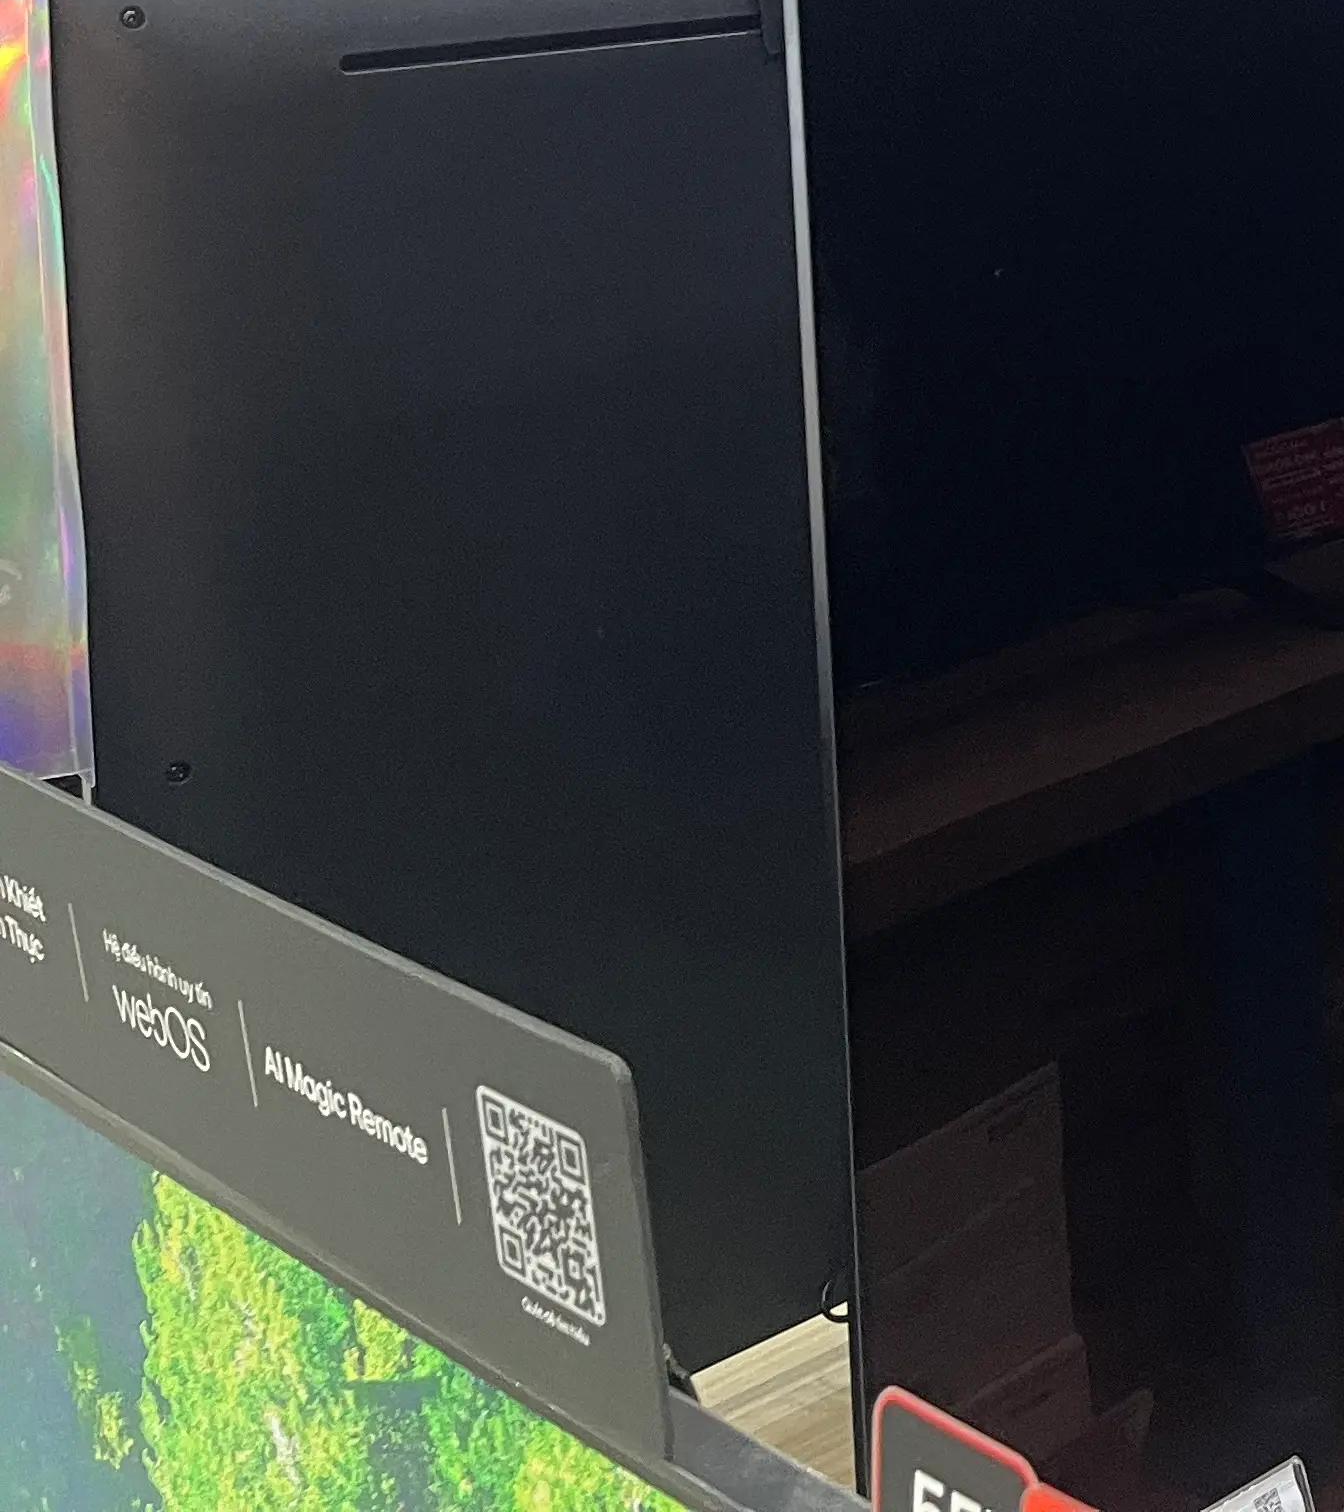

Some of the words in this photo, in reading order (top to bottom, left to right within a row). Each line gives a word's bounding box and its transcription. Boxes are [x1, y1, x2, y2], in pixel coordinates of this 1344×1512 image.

[112, 985, 210, 1072] webOS
[265, 1046, 284, 1084] AI
[284, 1056, 347, 1119] Magic
[347, 1091, 429, 1165] Remote
